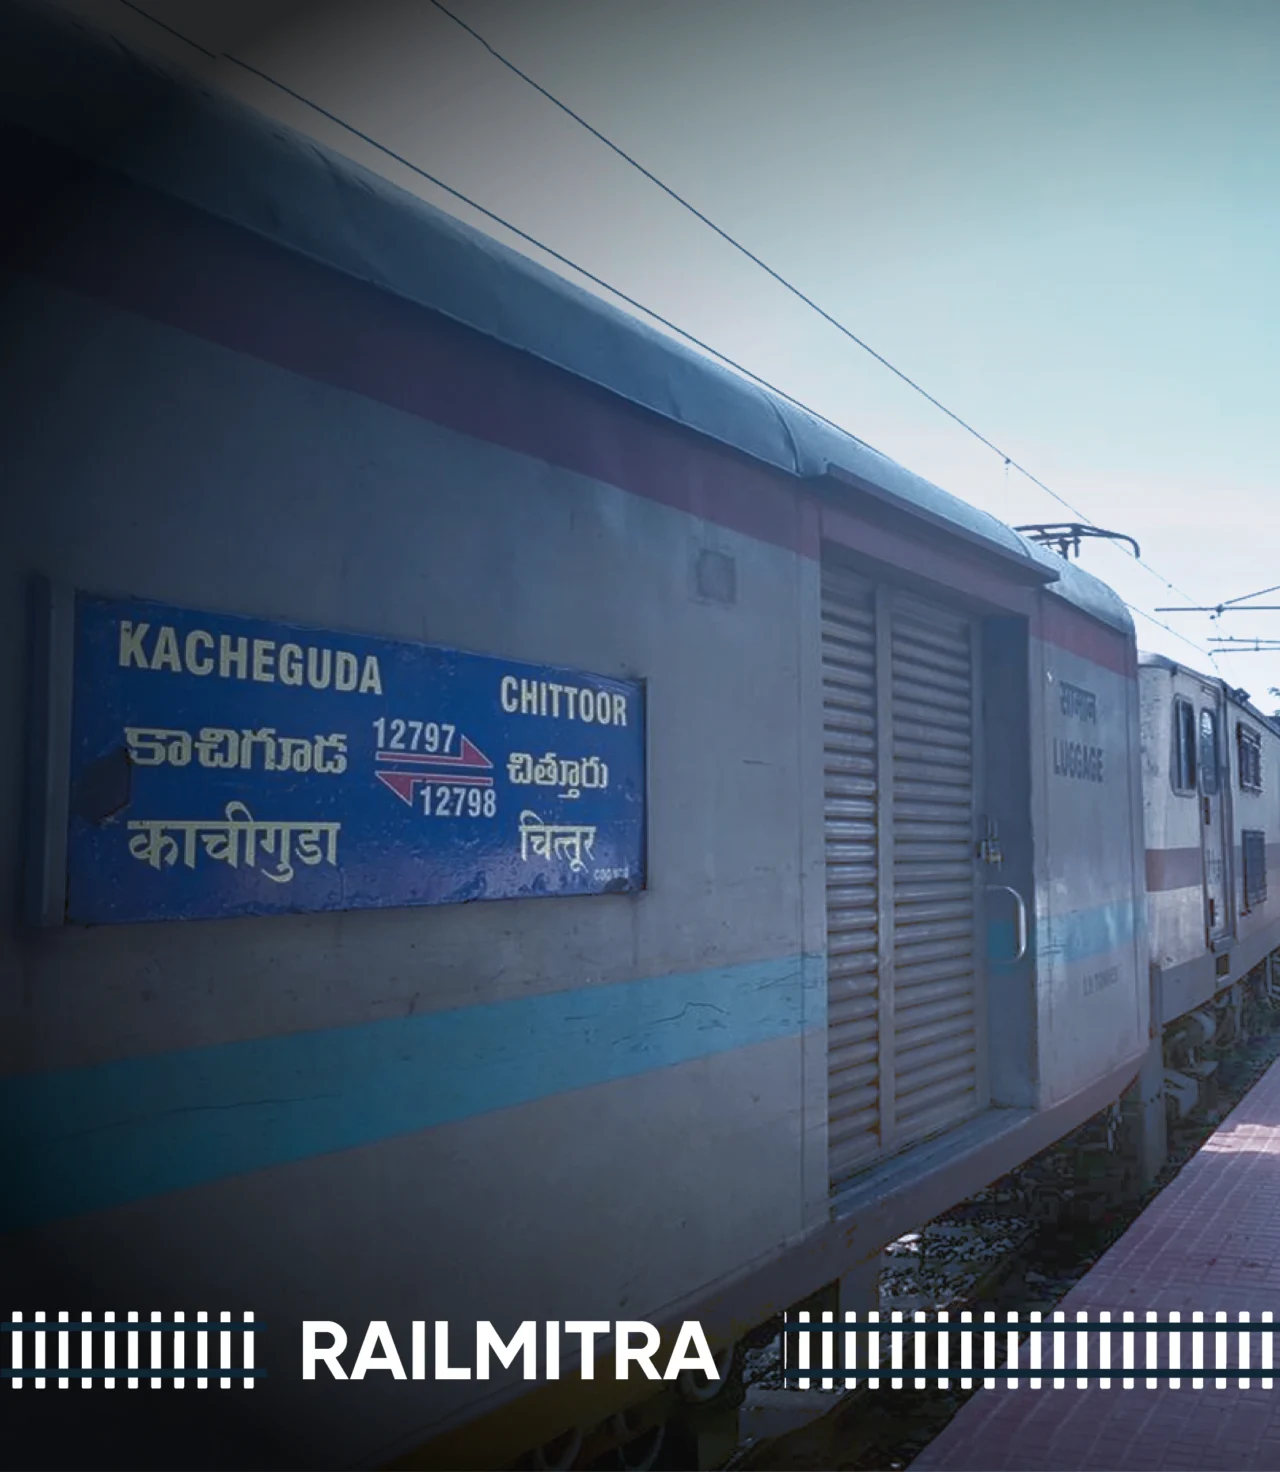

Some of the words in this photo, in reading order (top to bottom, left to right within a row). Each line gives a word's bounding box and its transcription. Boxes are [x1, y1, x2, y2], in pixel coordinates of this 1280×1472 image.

[118, 620, 383, 695] KACHEGUDA
[500, 675, 627, 727] CHITTOOR
[373, 718, 456, 753] 12797
[1052, 736, 1104, 783] LUGGAGE
[420, 784, 497, 818] 12798
[127, 801, 341, 882] काचीगुडा
[518, 809, 596, 873] चित्तूर
